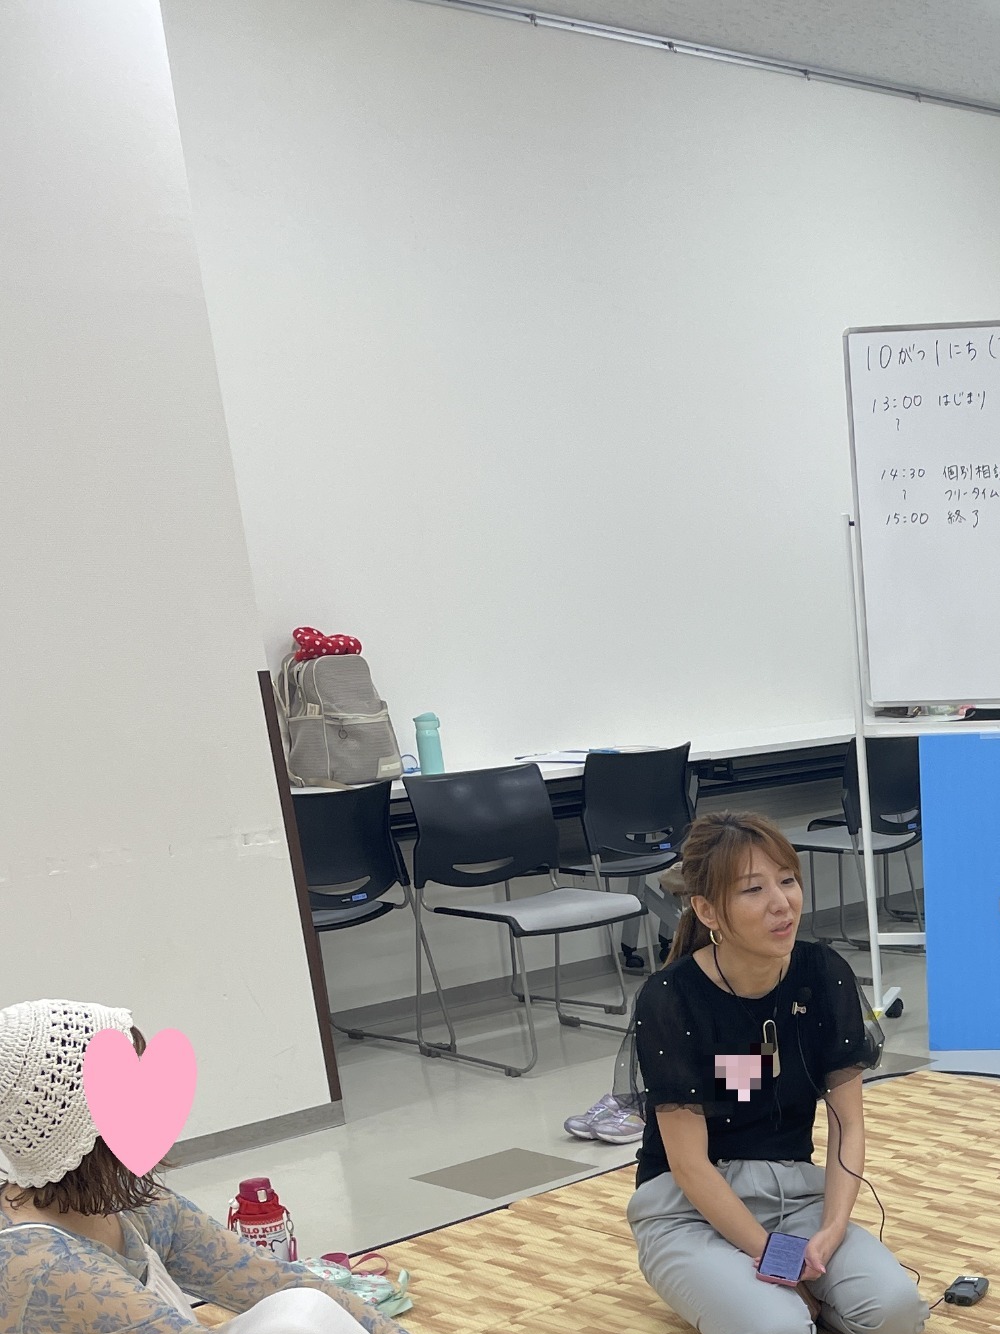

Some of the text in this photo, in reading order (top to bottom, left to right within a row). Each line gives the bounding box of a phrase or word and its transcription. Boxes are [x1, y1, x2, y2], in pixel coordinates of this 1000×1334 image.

[872, 390, 986, 413] 13:00 はじまり
[880, 467, 926, 481] 14:30
[944, 486, 1000, 501] フリータイム
[885, 508, 979, 528] 15:00 終了
